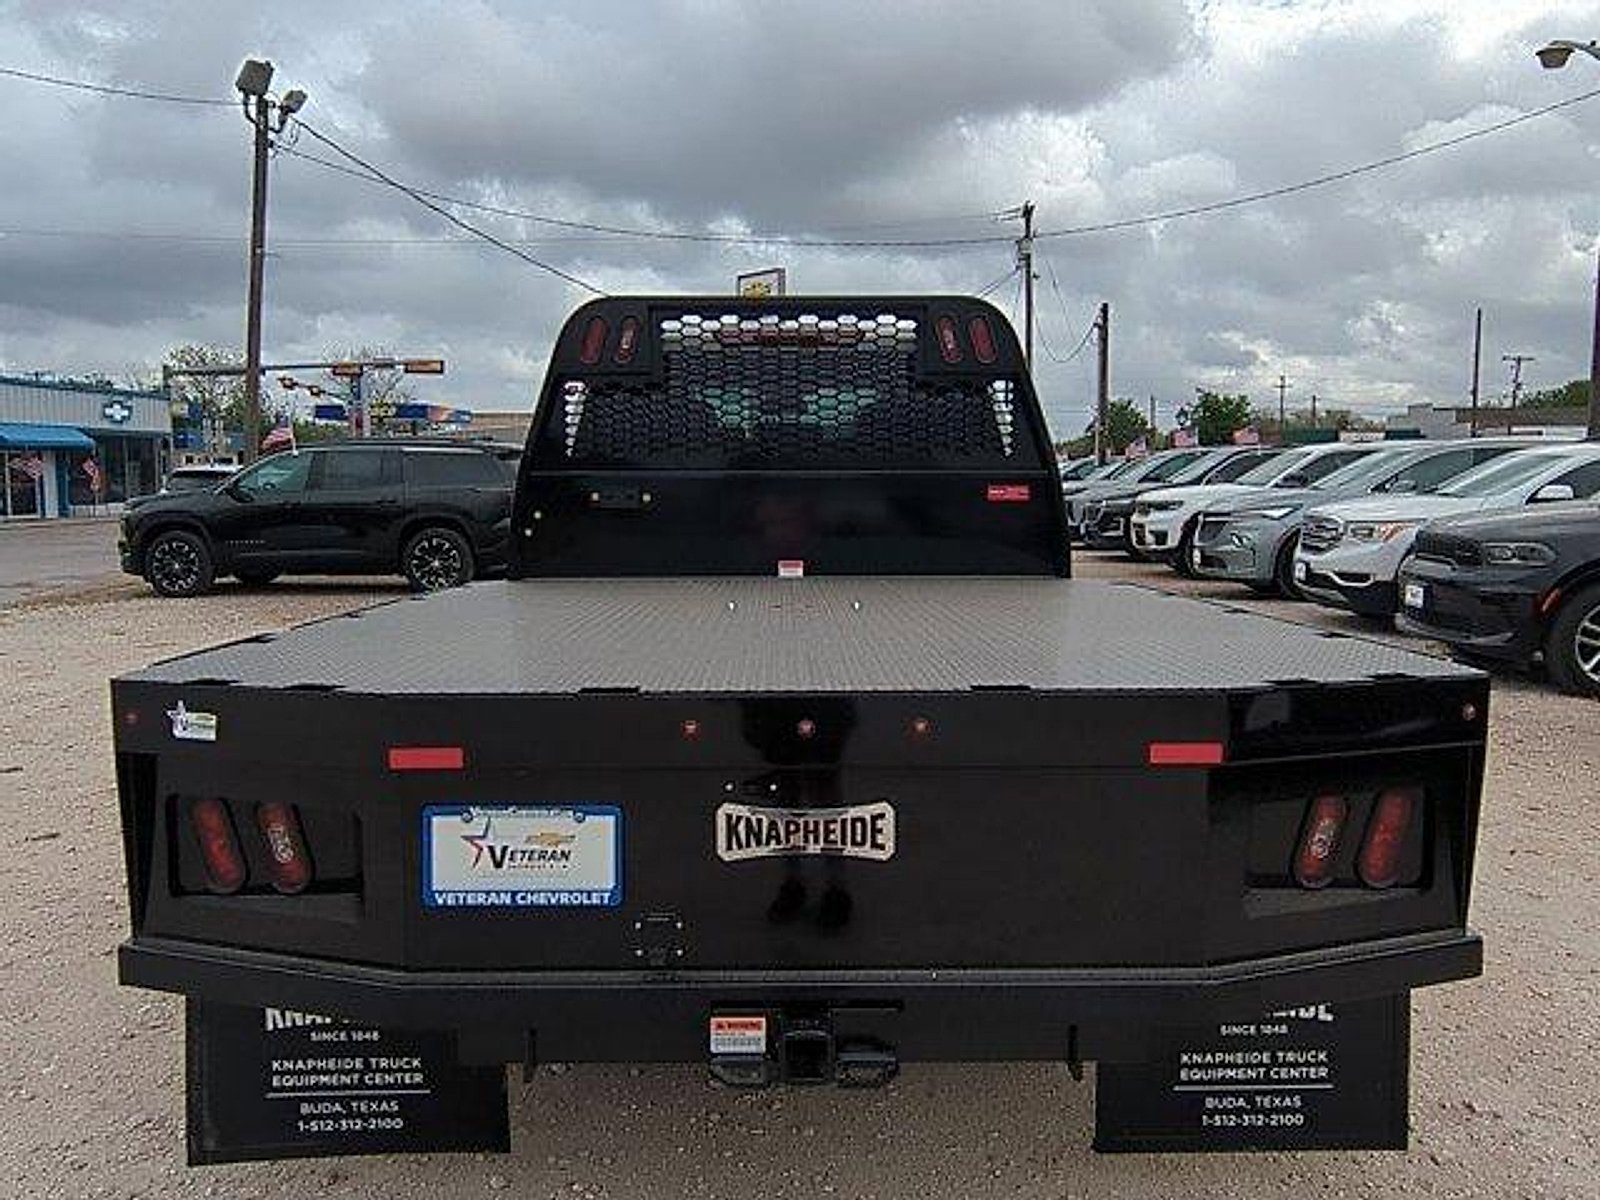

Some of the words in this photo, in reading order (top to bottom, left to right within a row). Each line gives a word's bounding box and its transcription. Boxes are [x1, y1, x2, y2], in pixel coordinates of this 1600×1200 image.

[725, 813, 886, 851] KNAPHEIDE
[487, 845, 571, 869] VETERAN
[434, 892, 511, 905] VETERAN
[516, 892, 612, 905] CHEVROLET
[310, 1031, 348, 1042] SINCE
[1220, 1024, 1256, 1035] SINCE
[272, 1058, 364, 1072] KNAPHEIDE
[368, 1057, 421, 1070] TRUCK
[1180, 1051, 1271, 1065] KNAPHEIDE
[1277, 1050, 1328, 1063] TRUCK
[272, 1073, 359, 1088] EQUIPMENT
[364, 1072, 424, 1085] CENTER
[1180, 1067, 1265, 1081] EQUIPMENT
[1270, 1067, 1329, 1079] CENTER
[300, 1102, 346, 1115] BUDA,
[351, 1100, 399, 1113] TEXAS
[1205, 1097, 1251, 1109] BUDA,
[1255, 1095, 1301, 1107] TEXAS
[297, 1118, 403, 1132] 1-512-312-2100
[1202, 1114, 1304, 1127] 1-512-312-2100
